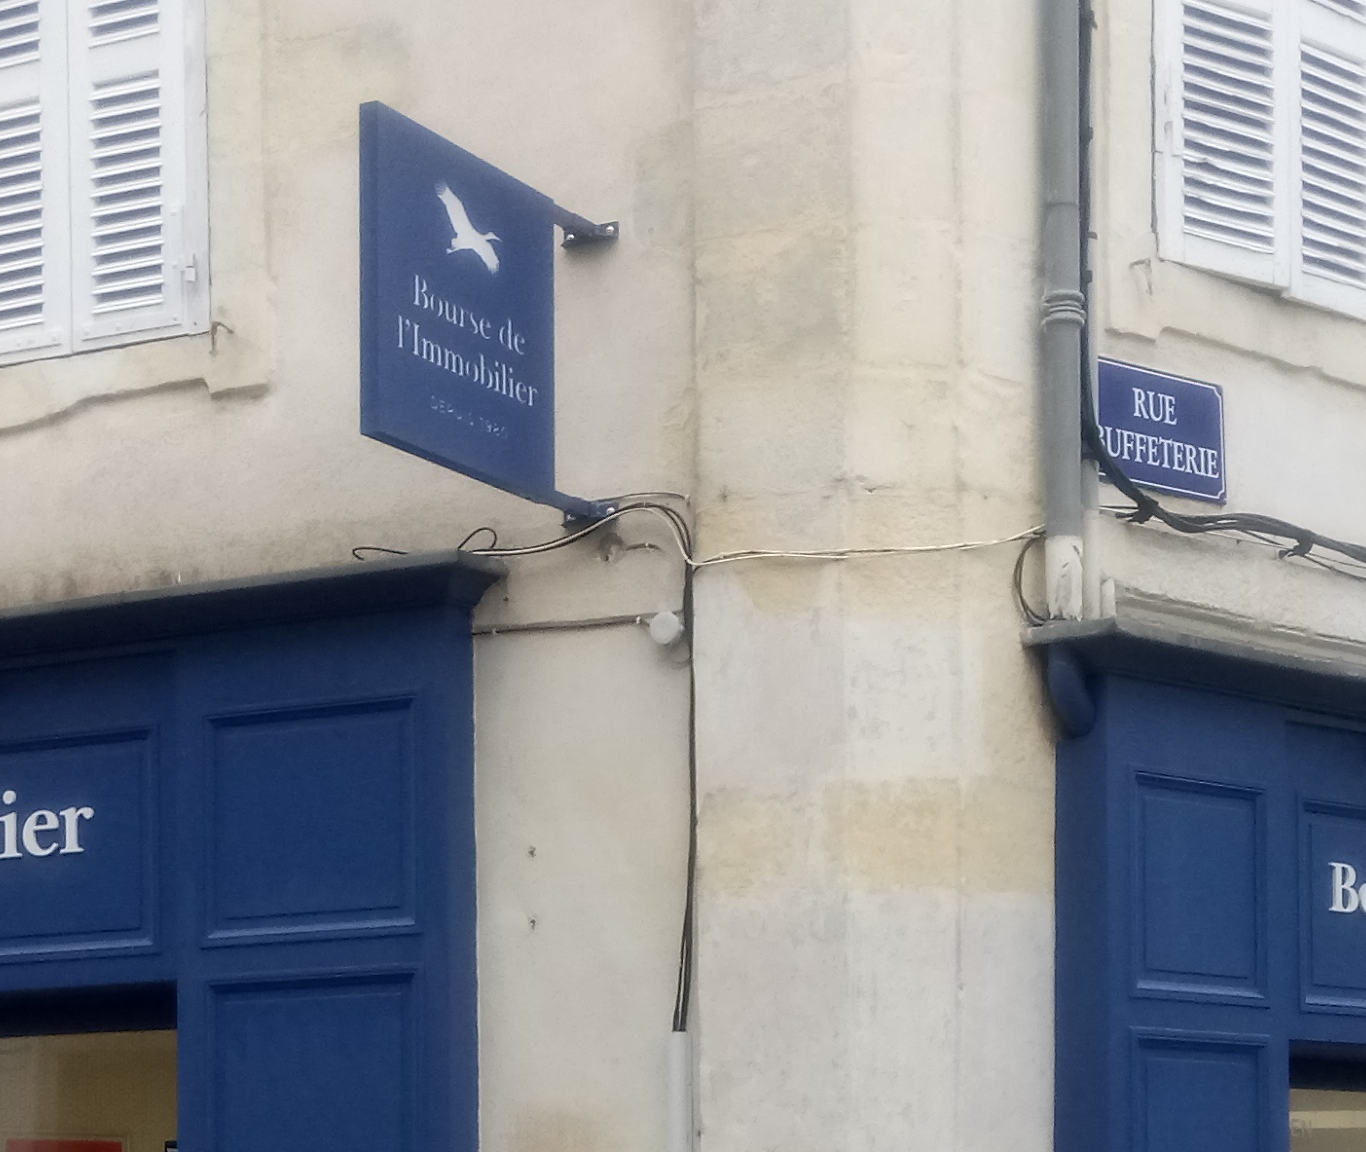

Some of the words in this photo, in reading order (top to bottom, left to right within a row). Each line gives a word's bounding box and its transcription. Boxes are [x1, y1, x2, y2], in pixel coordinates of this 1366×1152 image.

[413, 275, 492, 340] Bourse
[498, 319, 526, 356] de
[1132, 387, 1178, 426] RUE
